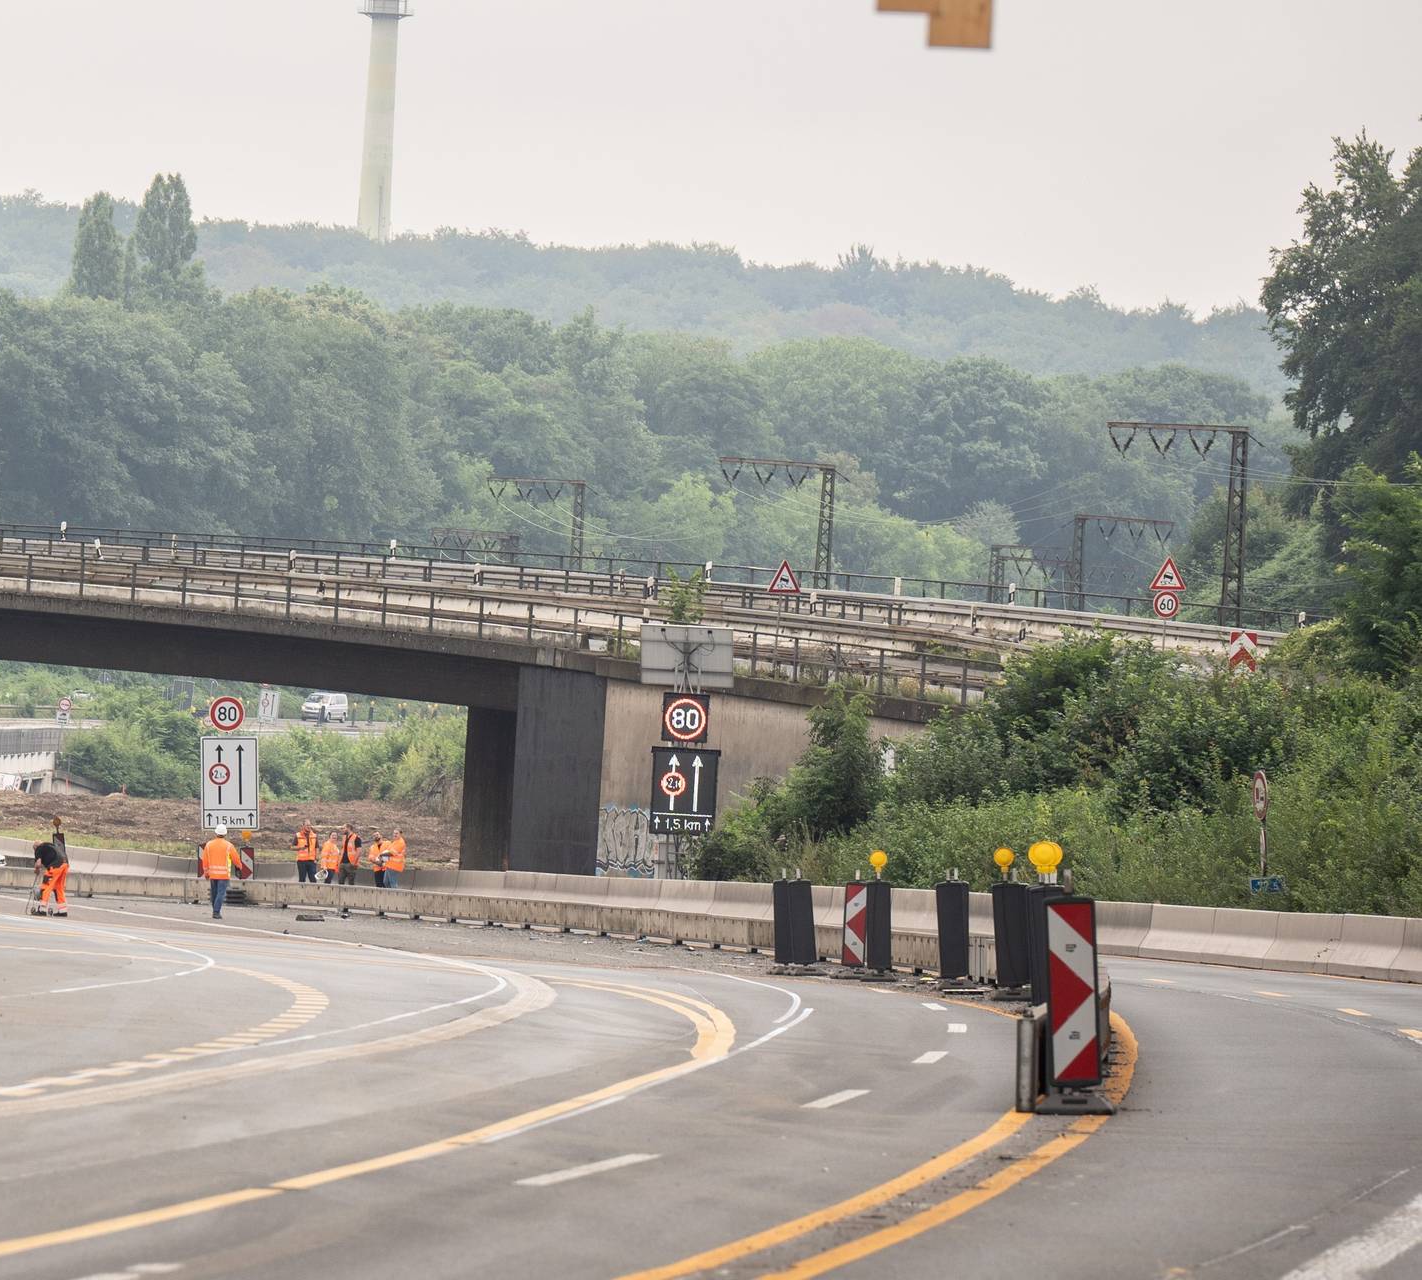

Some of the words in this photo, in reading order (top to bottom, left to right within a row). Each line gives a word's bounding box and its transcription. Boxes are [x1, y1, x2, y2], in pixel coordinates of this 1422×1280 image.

[1159, 598, 1174, 611] 60
[217, 706, 237, 722] 80
[671, 708, 699, 730] 80
[229, 816, 245, 825] km
[665, 818, 681, 832] 1,5
[684, 819, 701, 831] km
